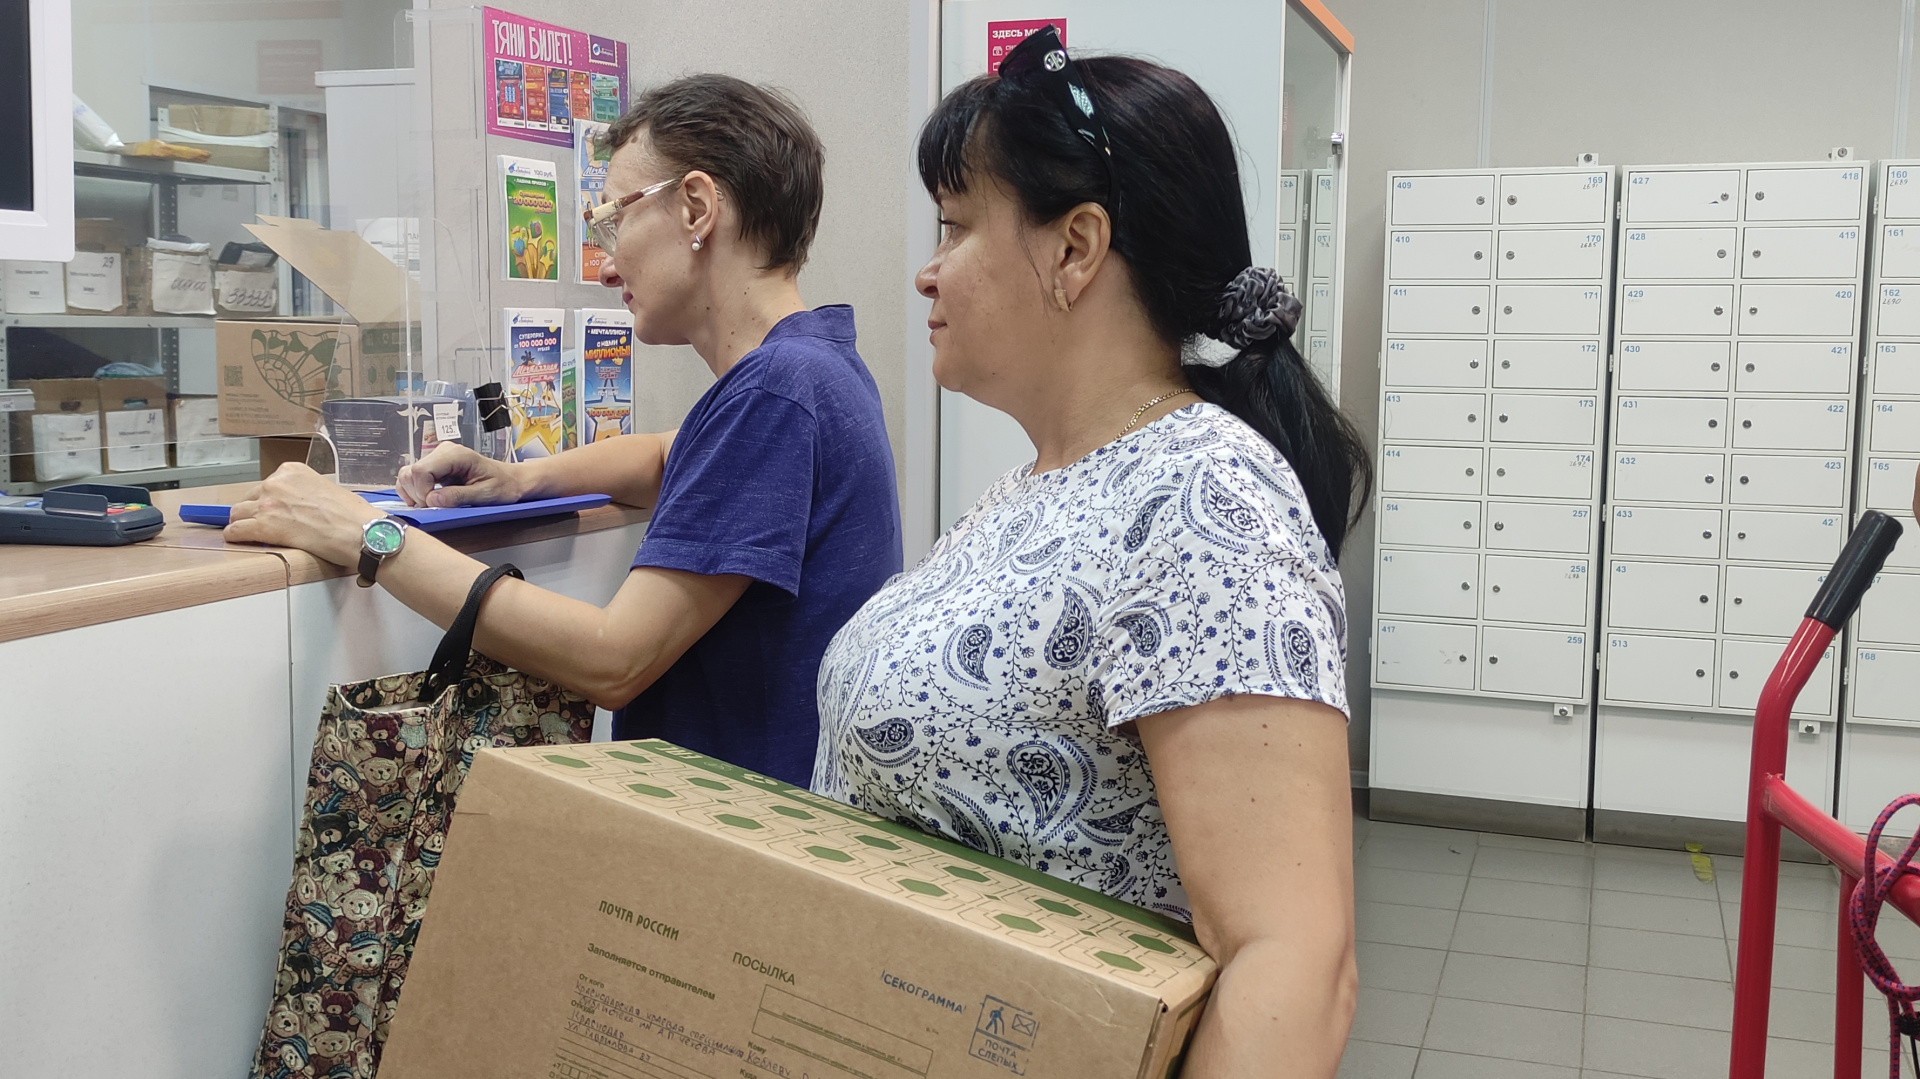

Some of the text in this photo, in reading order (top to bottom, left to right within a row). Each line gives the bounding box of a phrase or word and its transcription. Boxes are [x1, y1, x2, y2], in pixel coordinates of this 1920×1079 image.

[992, 30, 1023, 39] ЗДЕСЬ
[492, 20, 573, 66] ТЯНИ БИЛЕТ!
[1842, 172, 1859, 180] 418
[1891, 171, 1908, 179] 160
[1888, 229, 1904, 237] 161
[103, 256, 114, 268] 29
[1628, 290, 1644, 298] 429
[1625, 345, 1640, 353] 430
[1827, 404, 1844, 413] 422
[1877, 404, 1893, 412] 164
[1824, 461, 1841, 470] 423
[1873, 462, 1889, 470] 165
[598, 900, 680, 941] ПОЧТА РОССИИ
[587, 942, 716, 1001] Заполняется отправителем
[732, 951, 796, 985] ПОСЫЛКА
[589, 979, 605, 989] кого
[883, 973, 963, 1014] СЕКОГРАММА
[571, 1000, 595, 1014] Откуда
[747, 1041, 767, 1054] Кому
[984, 1039, 1017, 1058] ПОЧТА
[977, 1048, 1019, 1070] СЛЕПЫХ
